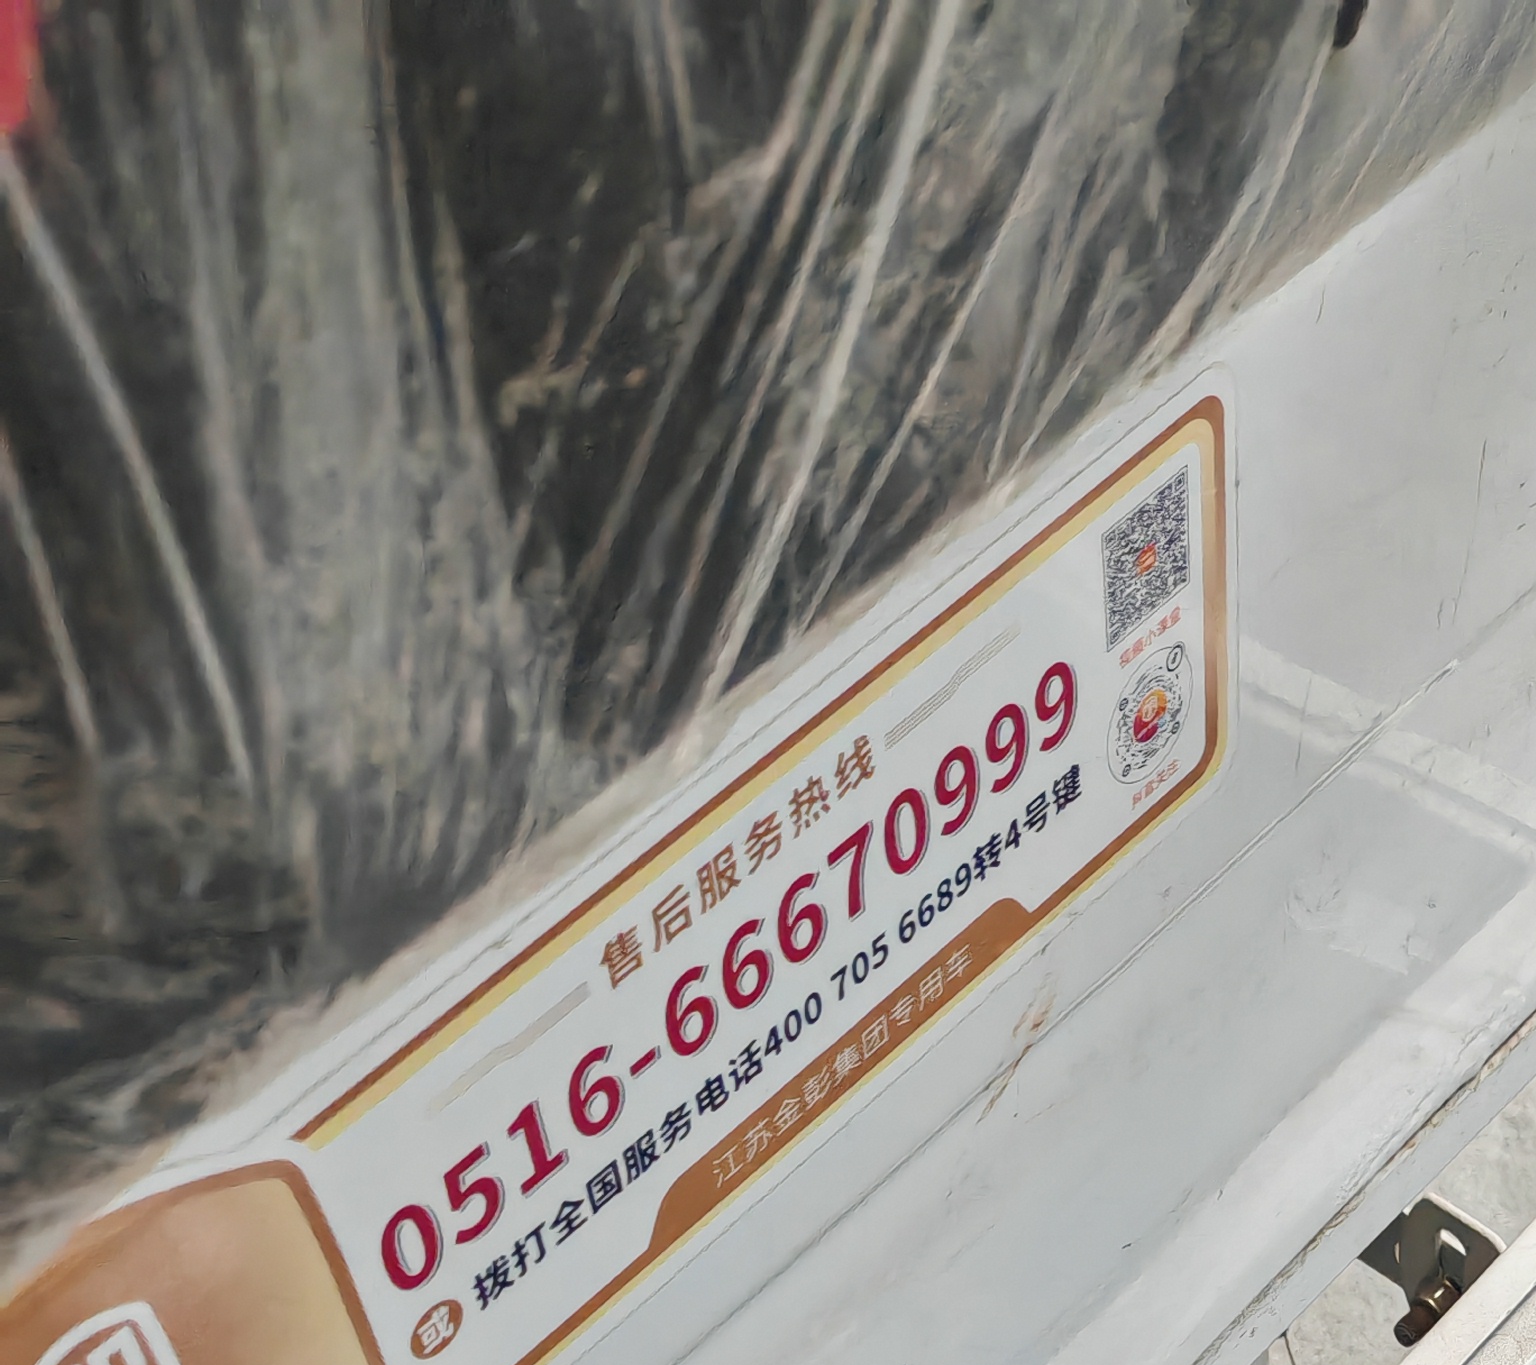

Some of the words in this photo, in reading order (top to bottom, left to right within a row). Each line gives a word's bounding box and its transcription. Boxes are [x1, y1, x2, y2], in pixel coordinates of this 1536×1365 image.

[380, 660, 1077, 1290] 0516-66670999
[417, 1306, 454, 1354] 或
[472, 993, 822, 1310] 拨打全国服务电话400
[830, 934, 889, 1001] 705
[898, 762, 1082, 940] 6689转4号键
[601, 736, 876, 990] 售后服务热线
[712, 944, 973, 1187] 江苏金彭集团专用车
